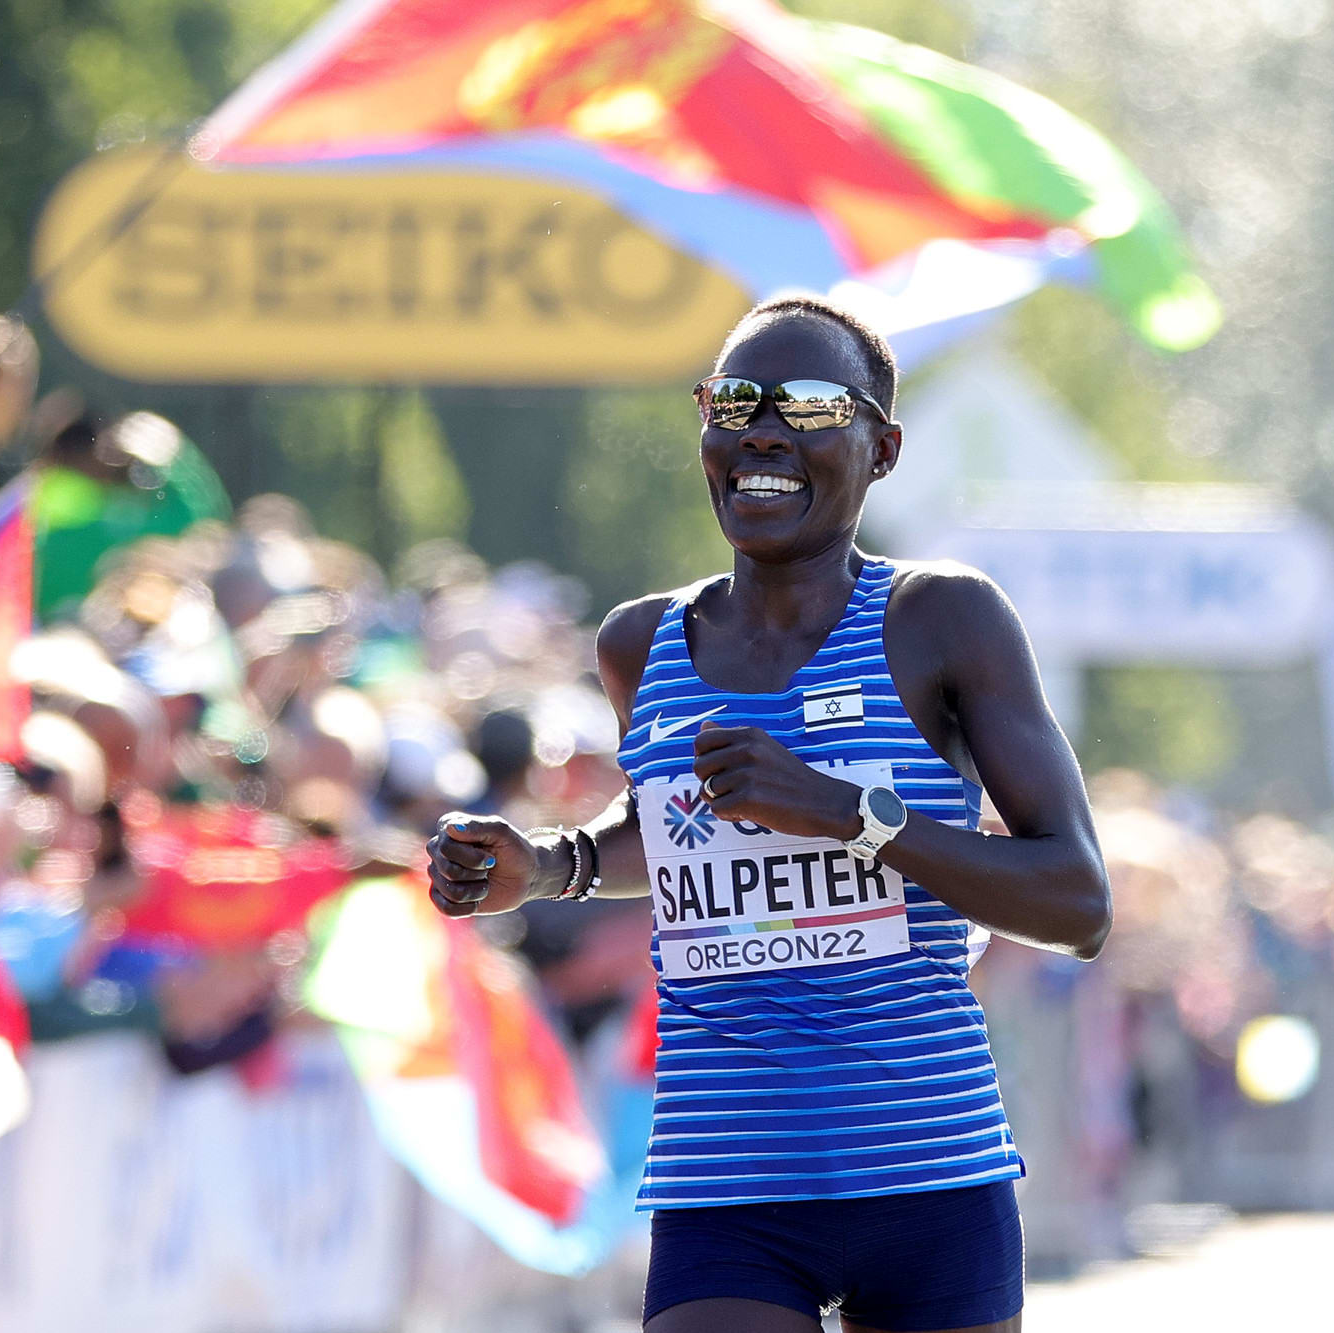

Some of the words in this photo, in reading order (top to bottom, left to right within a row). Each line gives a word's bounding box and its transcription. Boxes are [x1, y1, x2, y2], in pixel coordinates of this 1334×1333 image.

[110, 198, 705, 330] SEIKO
[657, 851, 888, 923] SALPETER
[686, 929, 867, 971] OREGON22
